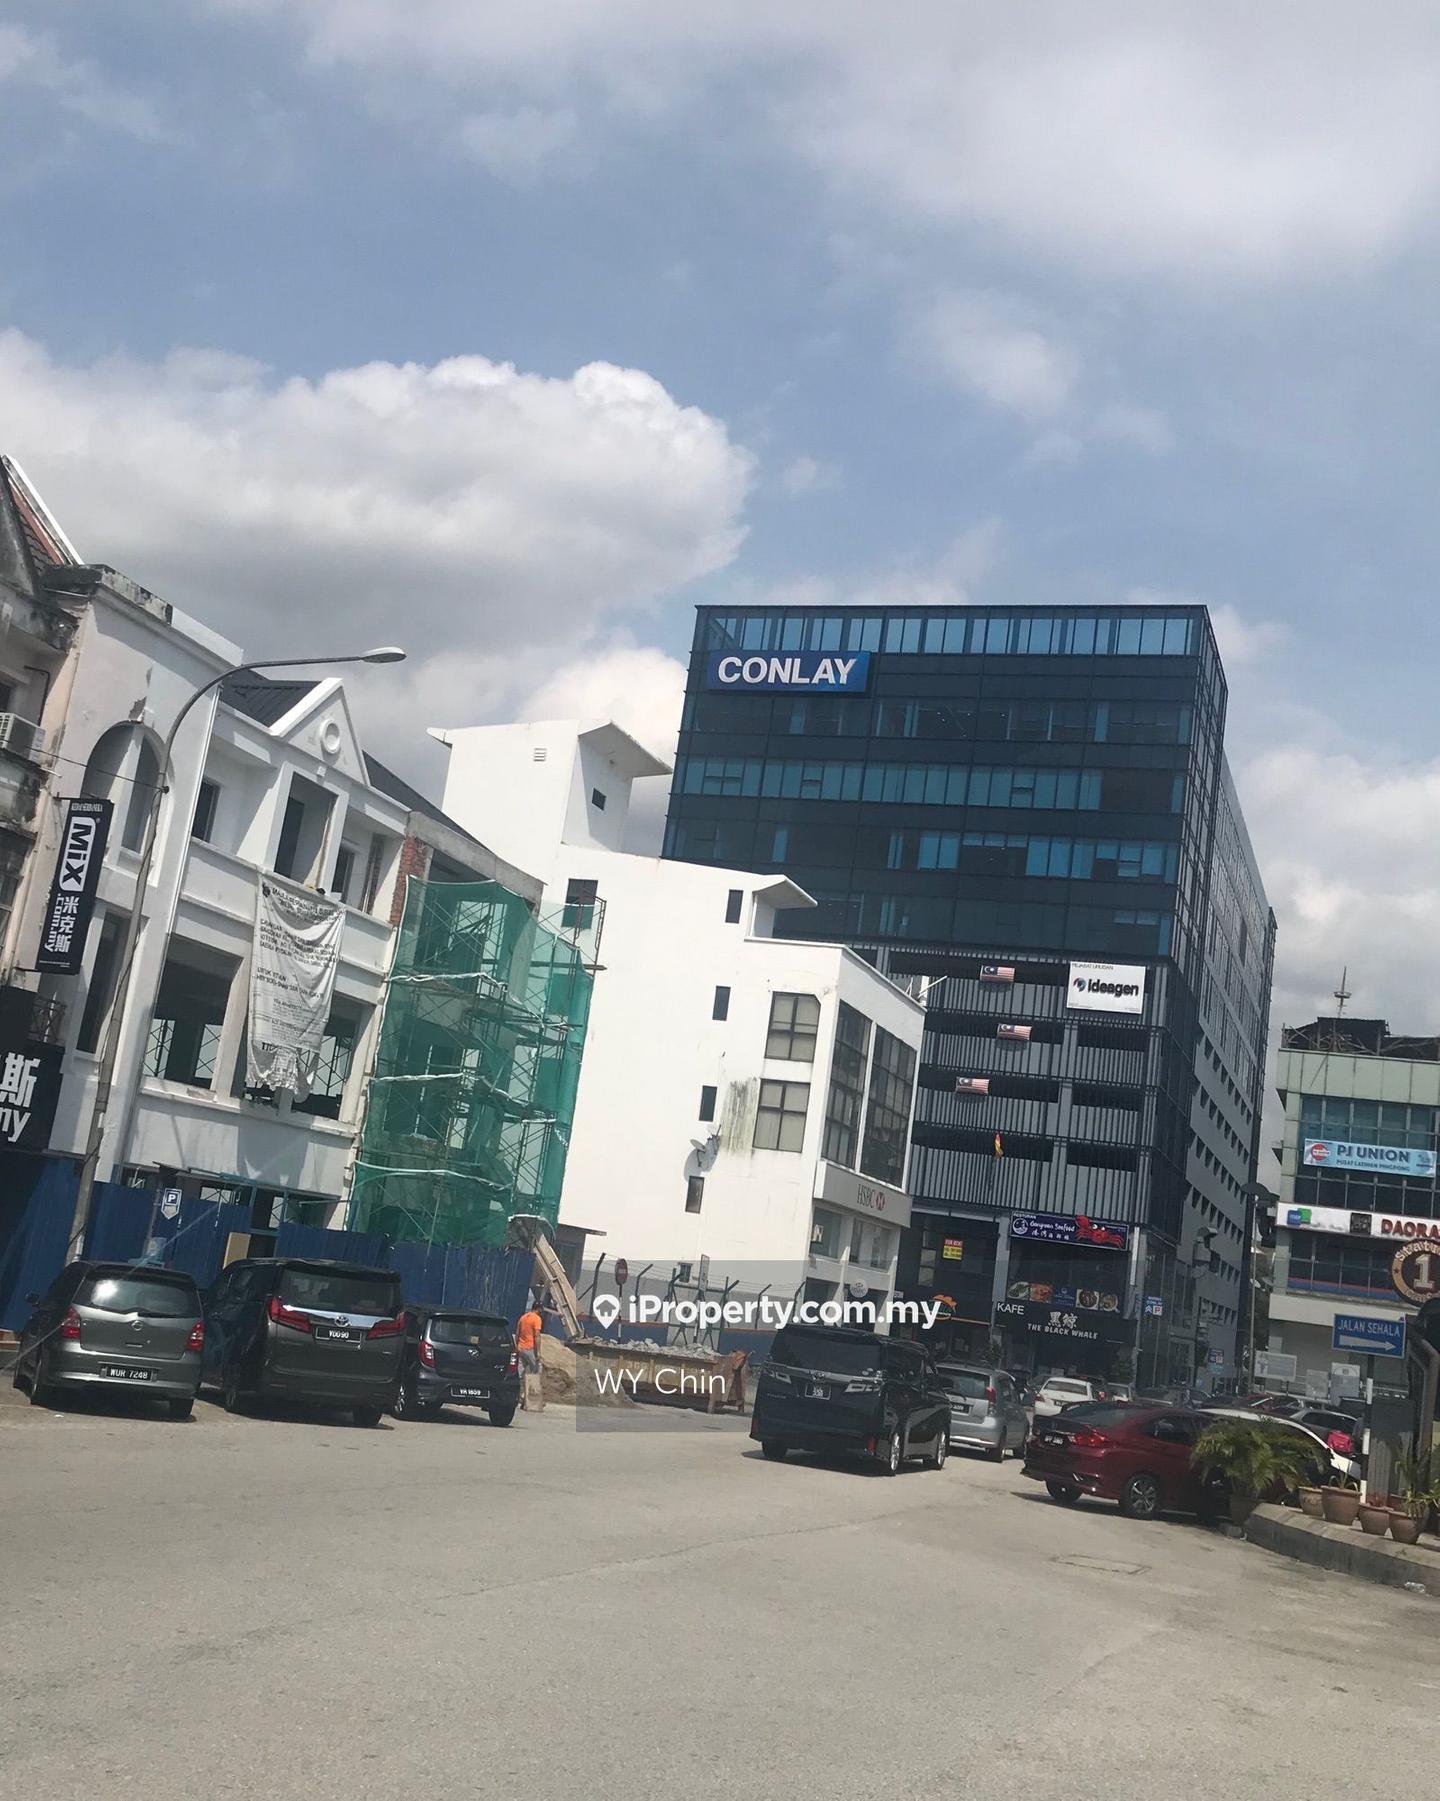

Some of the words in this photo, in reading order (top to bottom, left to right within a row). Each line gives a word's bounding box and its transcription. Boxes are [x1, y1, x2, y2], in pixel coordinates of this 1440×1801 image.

[718, 657, 857, 685] CONLAY
[54, 896, 79, 953] 米克斯
[1087, 978, 1139, 998] ideagen
[0, 1052, 41, 1108] 斯
[1336, 1144, 1353, 1157] PJ
[1356, 1146, 1409, 1163] UNION
[857, 1183, 876, 1209] HSBC
[997, 1302, 1025, 1316] KAFE
[1027, 1323, 1042, 1332] THE
[1044, 1325, 1070, 1336] BLACK
[1071, 1329, 1099, 1340] WHALE
[1338, 1319, 1366, 1332] JALAN
[1367, 1322, 1400, 1337] SEHALA
[129, 1370, 148, 1379] 7248
